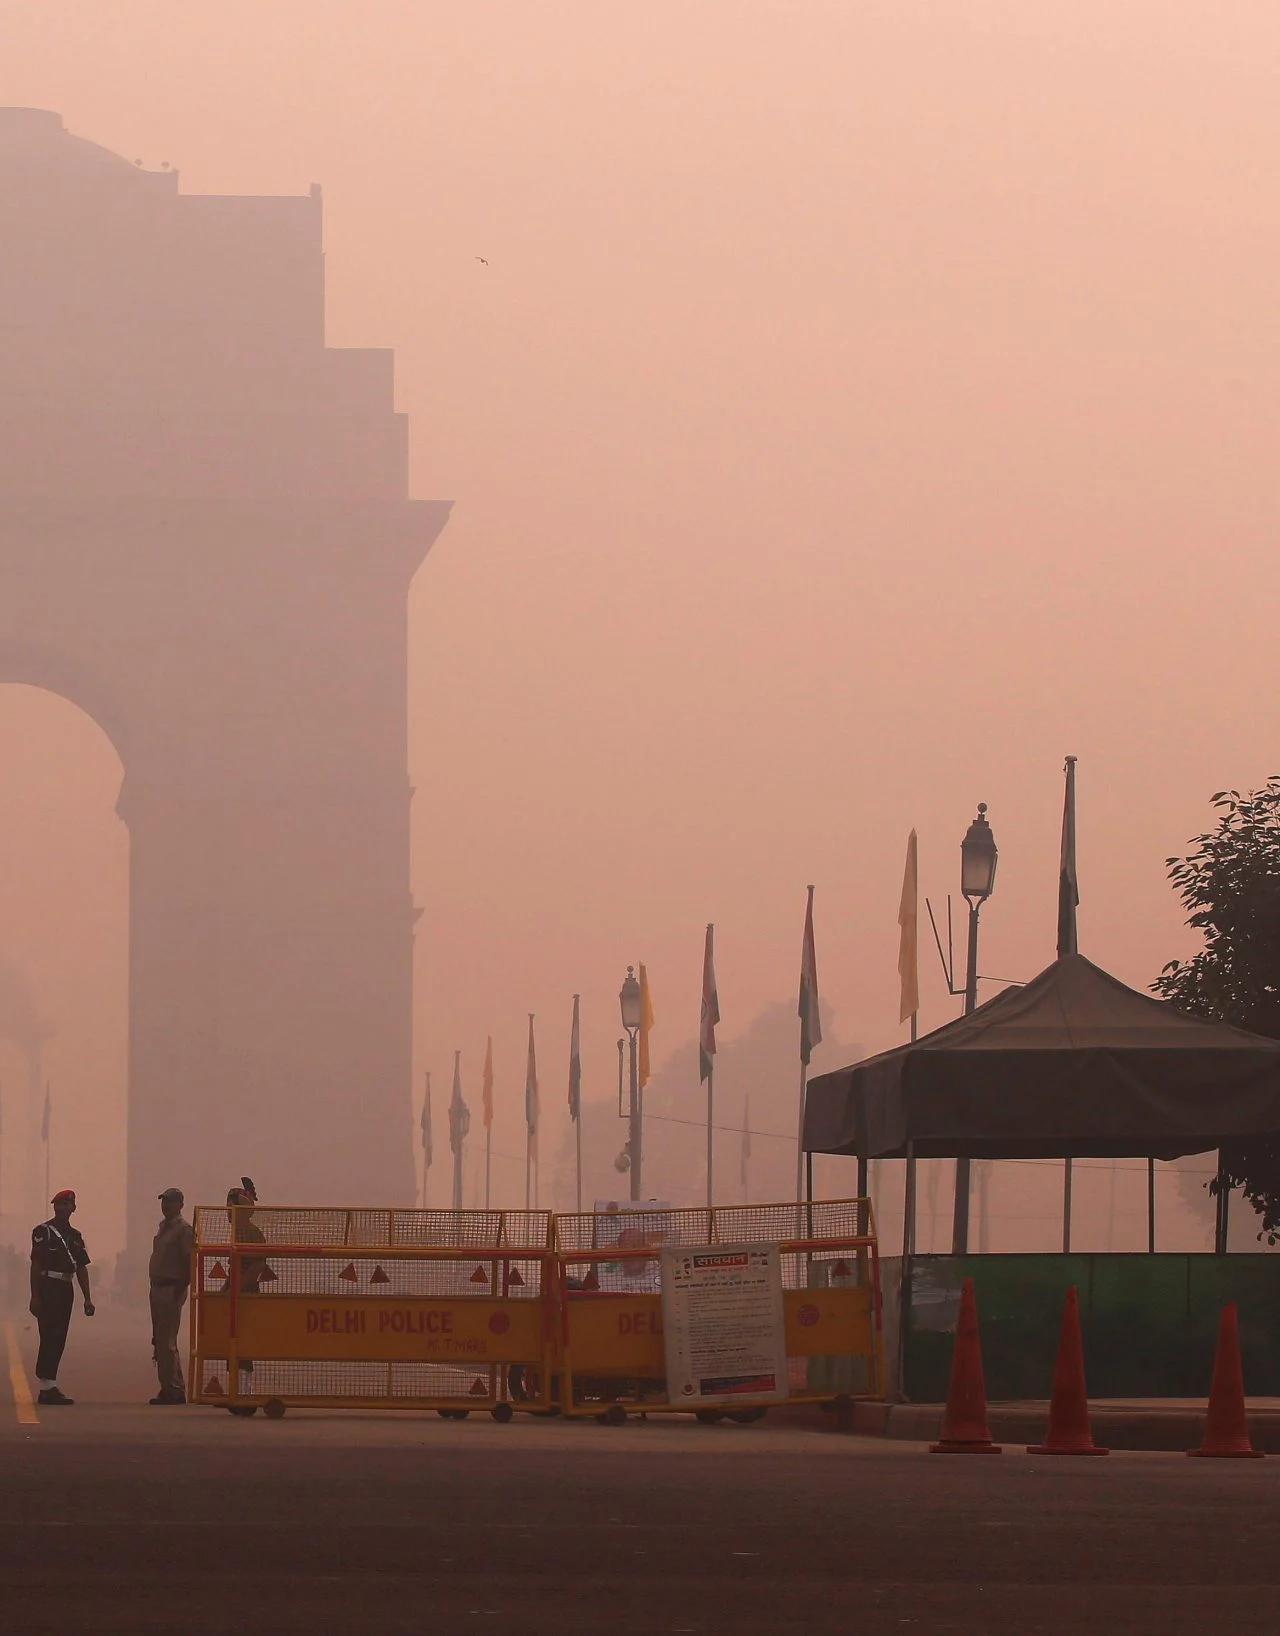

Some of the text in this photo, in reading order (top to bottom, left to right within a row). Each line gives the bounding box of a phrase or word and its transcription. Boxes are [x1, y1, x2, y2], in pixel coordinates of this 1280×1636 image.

[695, 1254, 747, 1267] सावधान
[306, 1309, 454, 1334] DELHI POLICE
